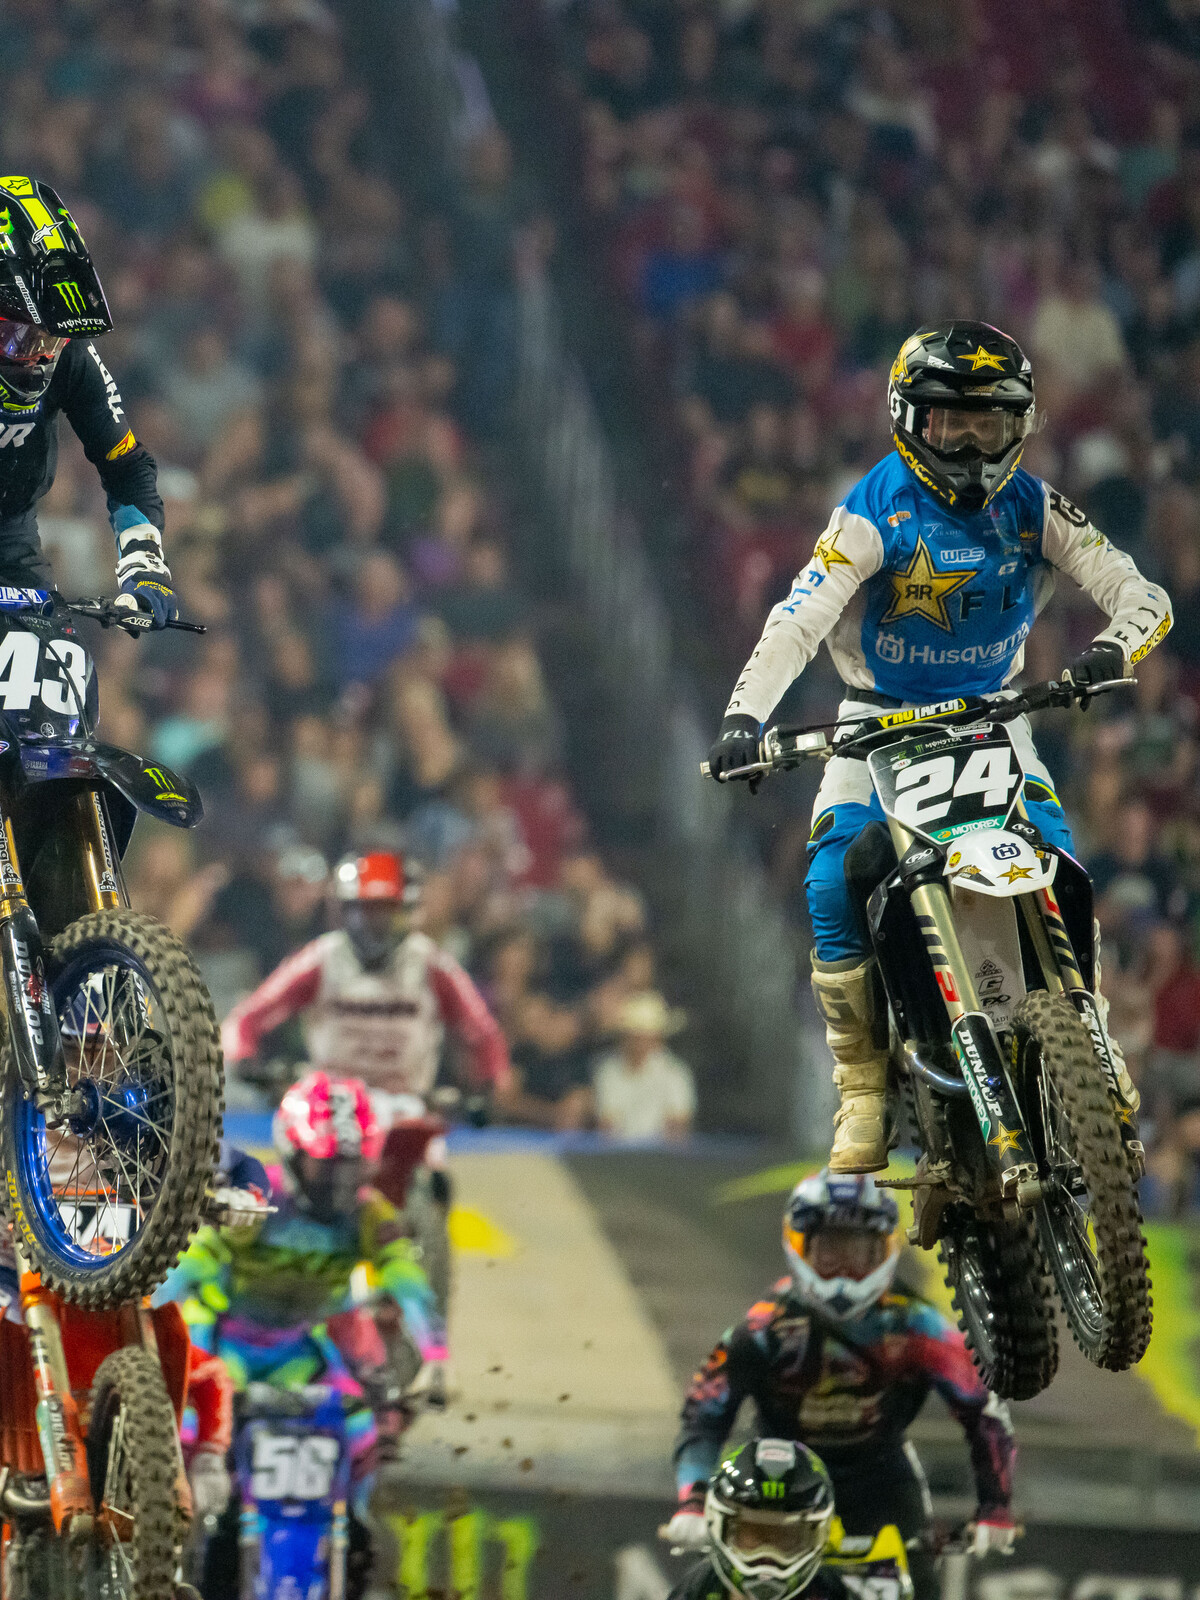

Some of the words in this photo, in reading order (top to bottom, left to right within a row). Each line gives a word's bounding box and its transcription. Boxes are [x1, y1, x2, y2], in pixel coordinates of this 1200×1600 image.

[57, 318, 107, 329] MONSTER
[940, 547, 985, 563] WPS
[121, 616, 153, 628] ARC
[910, 621, 1030, 664] Husqvarna
[878, 699, 960, 728] PROTAPER
[722, 729, 754, 742] FLY
[954, 724, 989, 733] HAMPSHIRE
[925, 736, 962, 749] MONSTER
[893, 746, 1020, 828] 24
[951, 818, 1000, 836] MOTOREX
[13, 938, 45, 1046] DUNLOP
[958, 1029, 1004, 1117] DUNLOP
[959, 1056, 989, 1128] MOTOREX
[251, 1432, 339, 1500] 56
